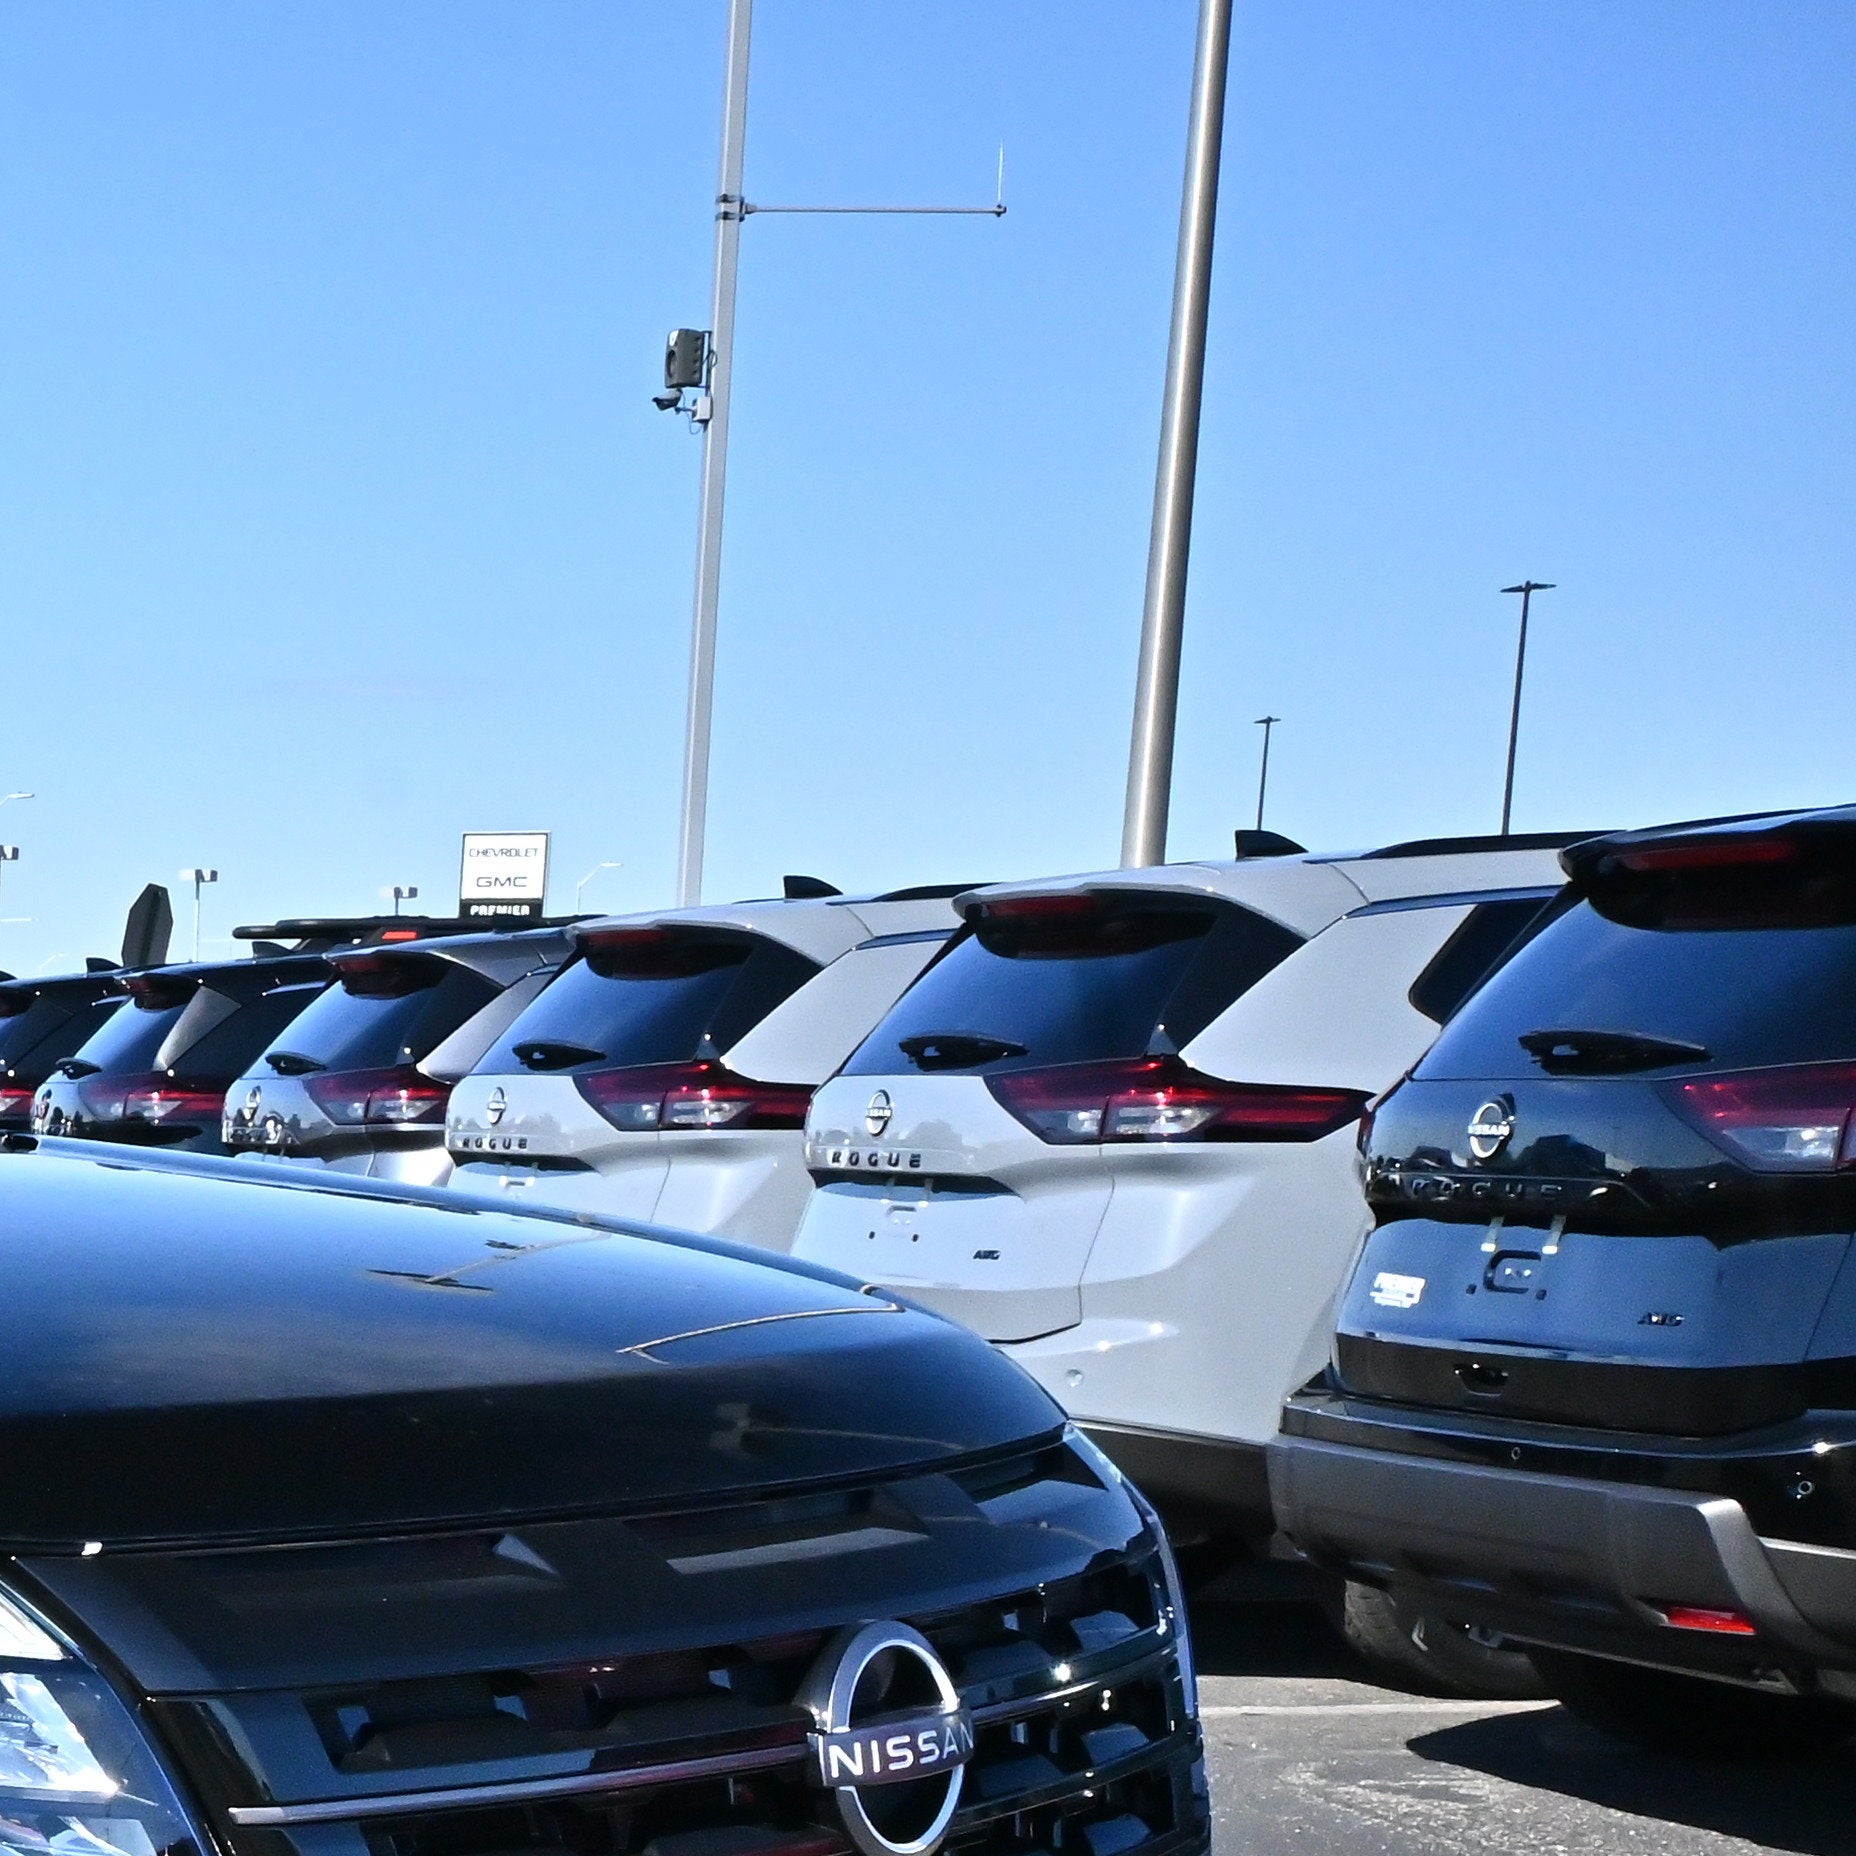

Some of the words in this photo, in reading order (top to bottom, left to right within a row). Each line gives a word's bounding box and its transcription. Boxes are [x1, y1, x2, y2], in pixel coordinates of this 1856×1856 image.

[469, 848, 538, 858] CHEVROLET
[476, 876, 528, 887] GMC
[470, 904, 530, 916] PREMIER
[462, 1137, 528, 1150] ROGUE
[831, 1151, 922, 1169] ROGUE
[828, 1721, 975, 1779] NISSAN
